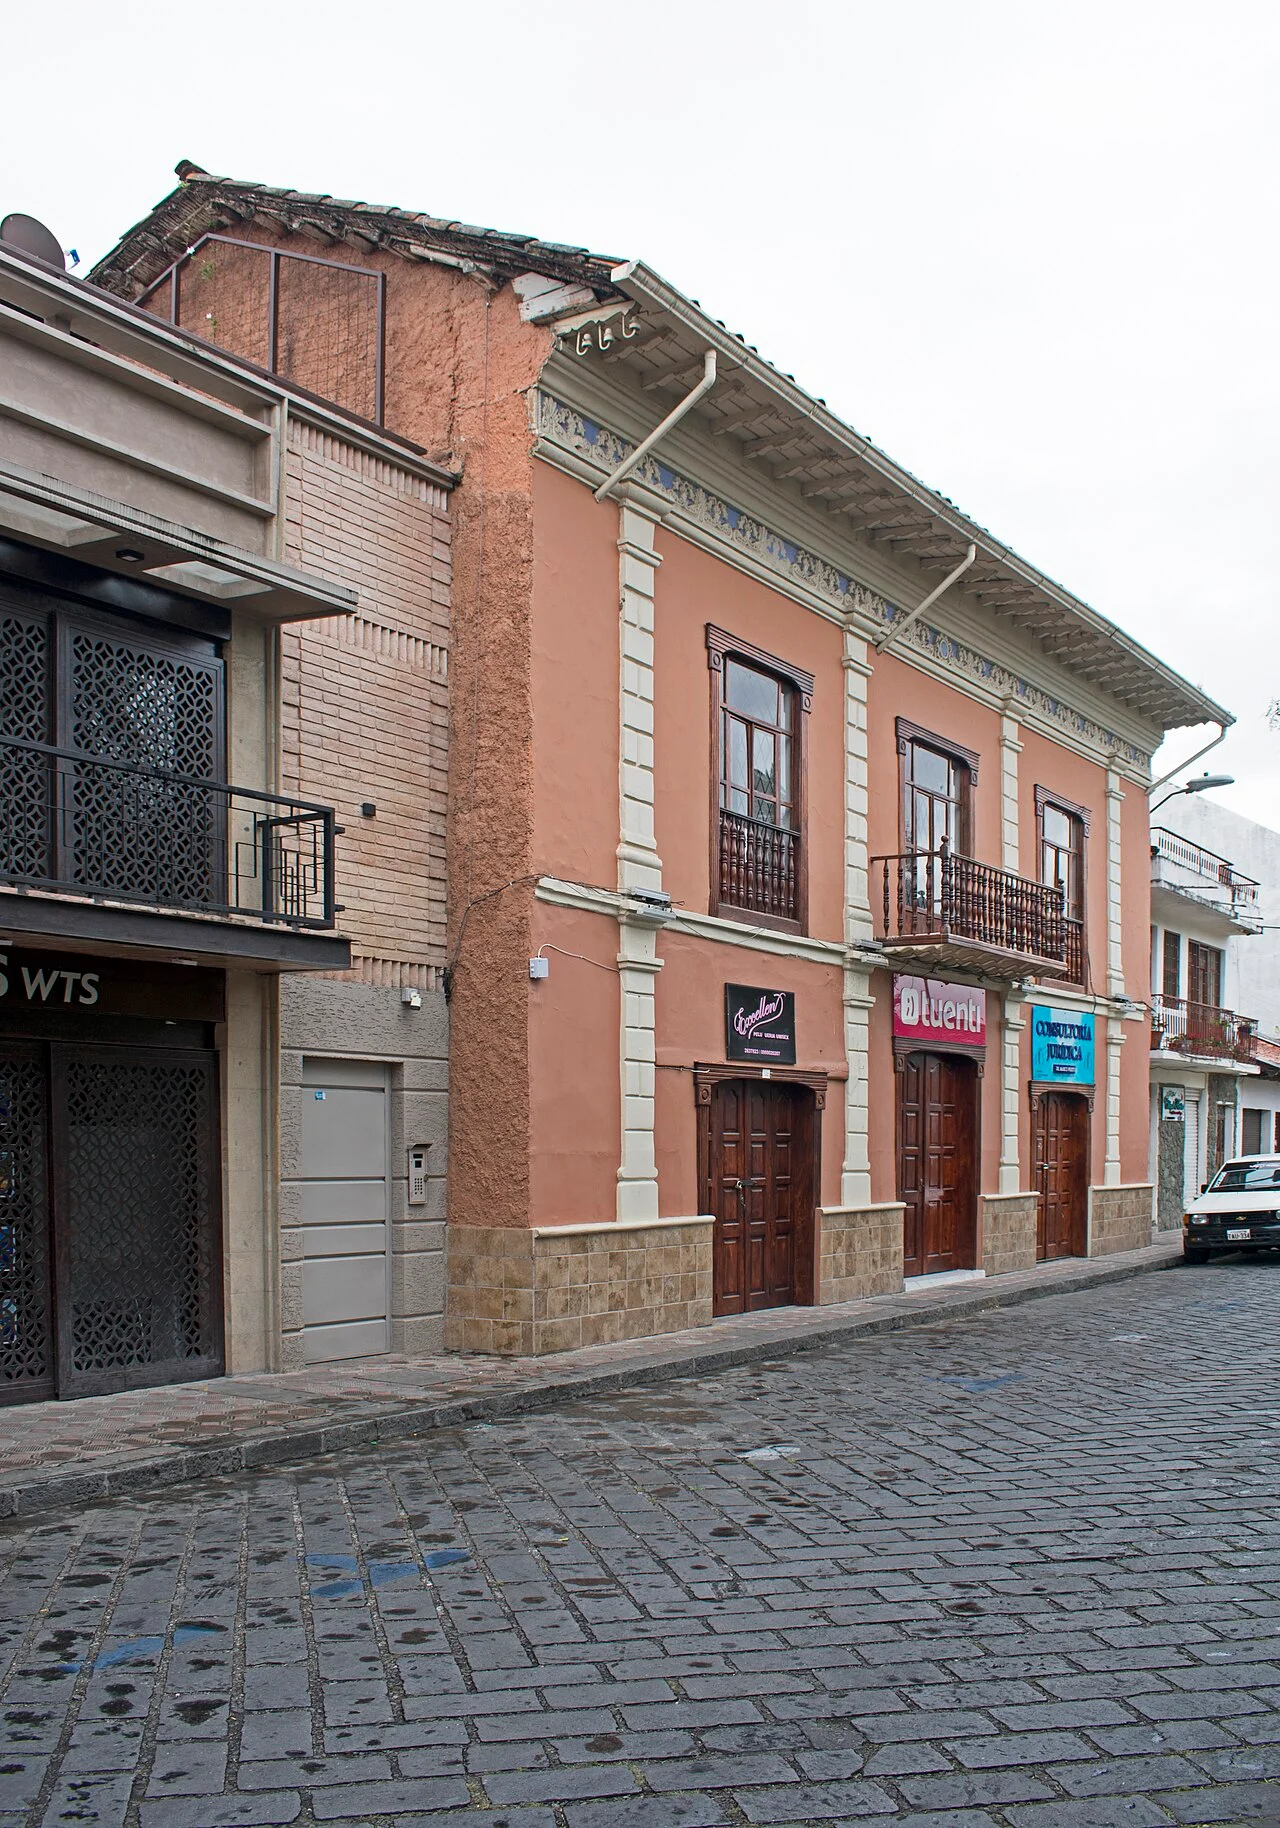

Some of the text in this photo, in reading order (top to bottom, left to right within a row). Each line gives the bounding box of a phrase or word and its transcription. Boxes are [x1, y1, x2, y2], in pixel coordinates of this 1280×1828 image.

[21, 966, 100, 1005] WTS
[921, 990, 981, 1033] tuenti
[1035, 1020, 1093, 1041] CONSULTORÍA
[1046, 1042, 1083, 1061] JURÍDICA
